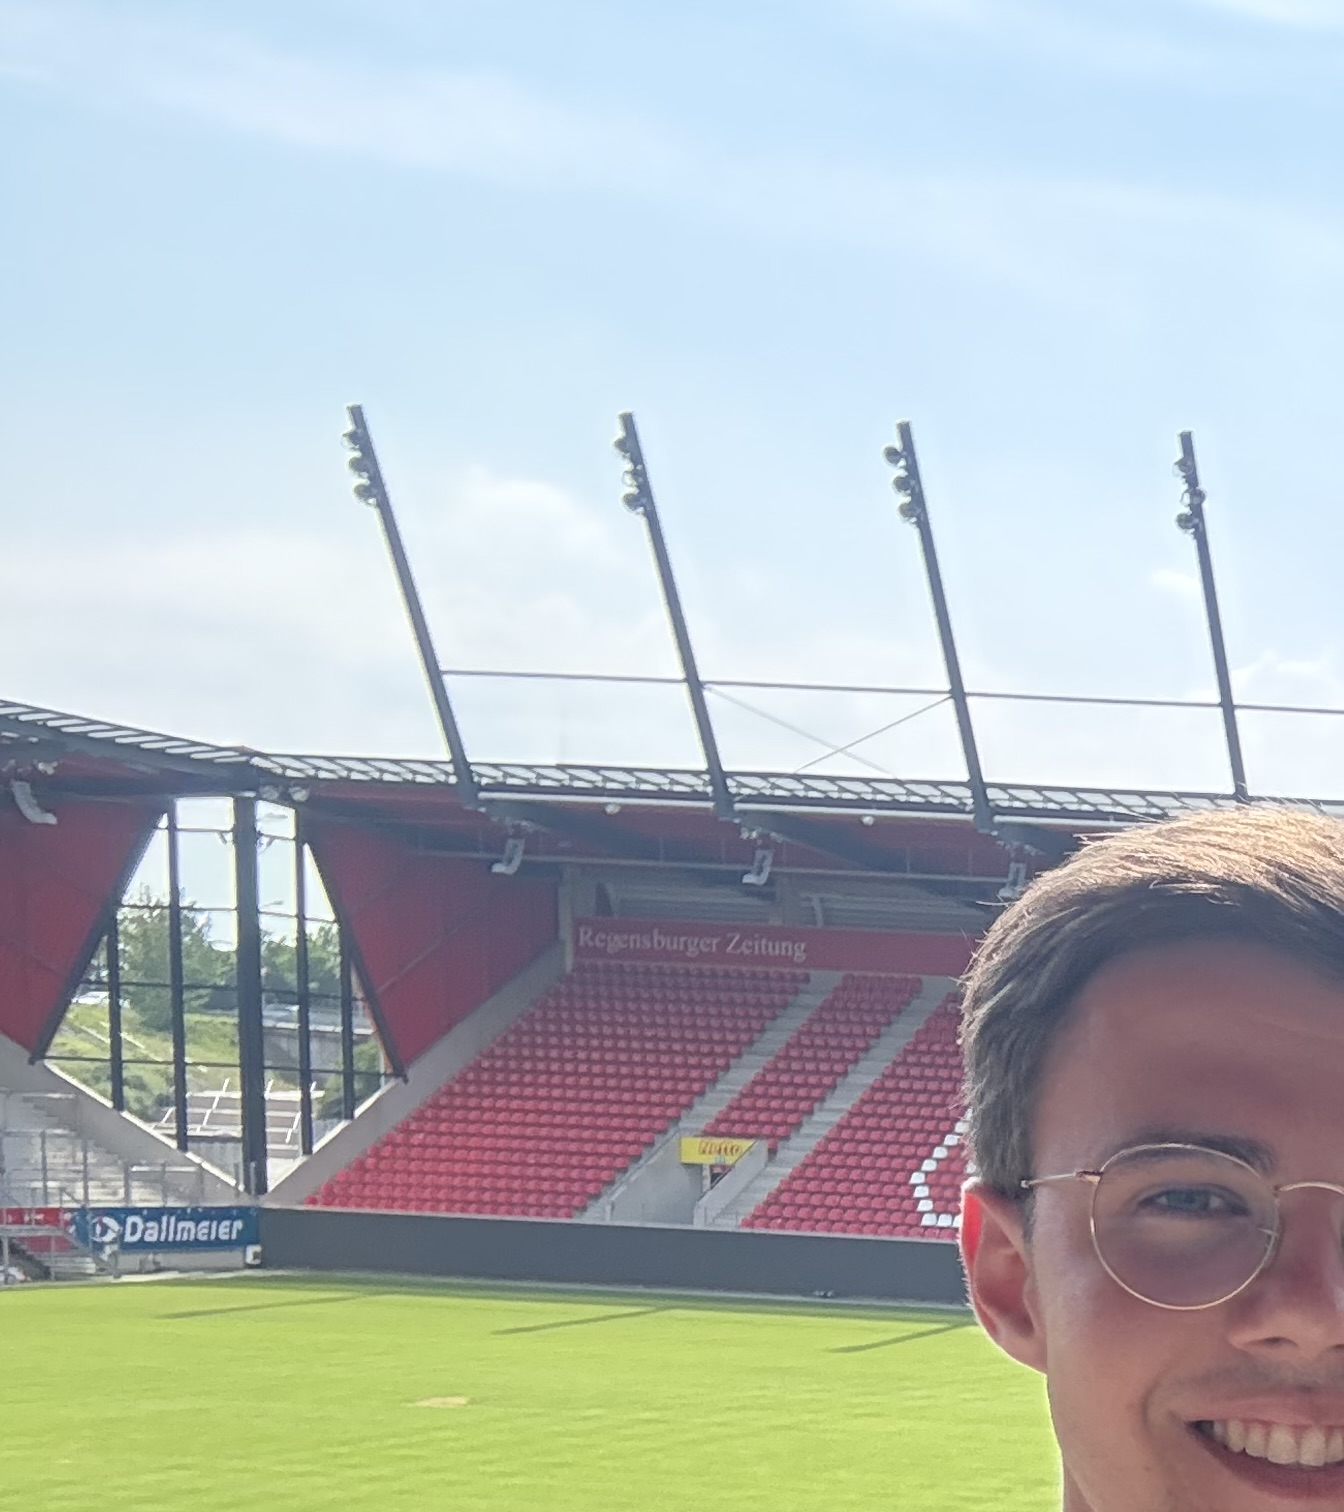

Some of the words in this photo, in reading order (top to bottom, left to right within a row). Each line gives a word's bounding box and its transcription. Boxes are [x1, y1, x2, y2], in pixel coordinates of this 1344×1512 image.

[579, 926, 719, 957] Regensburger
[727, 932, 806, 962] Zeitung
[124, 1215, 242, 1242] Dallmeier
